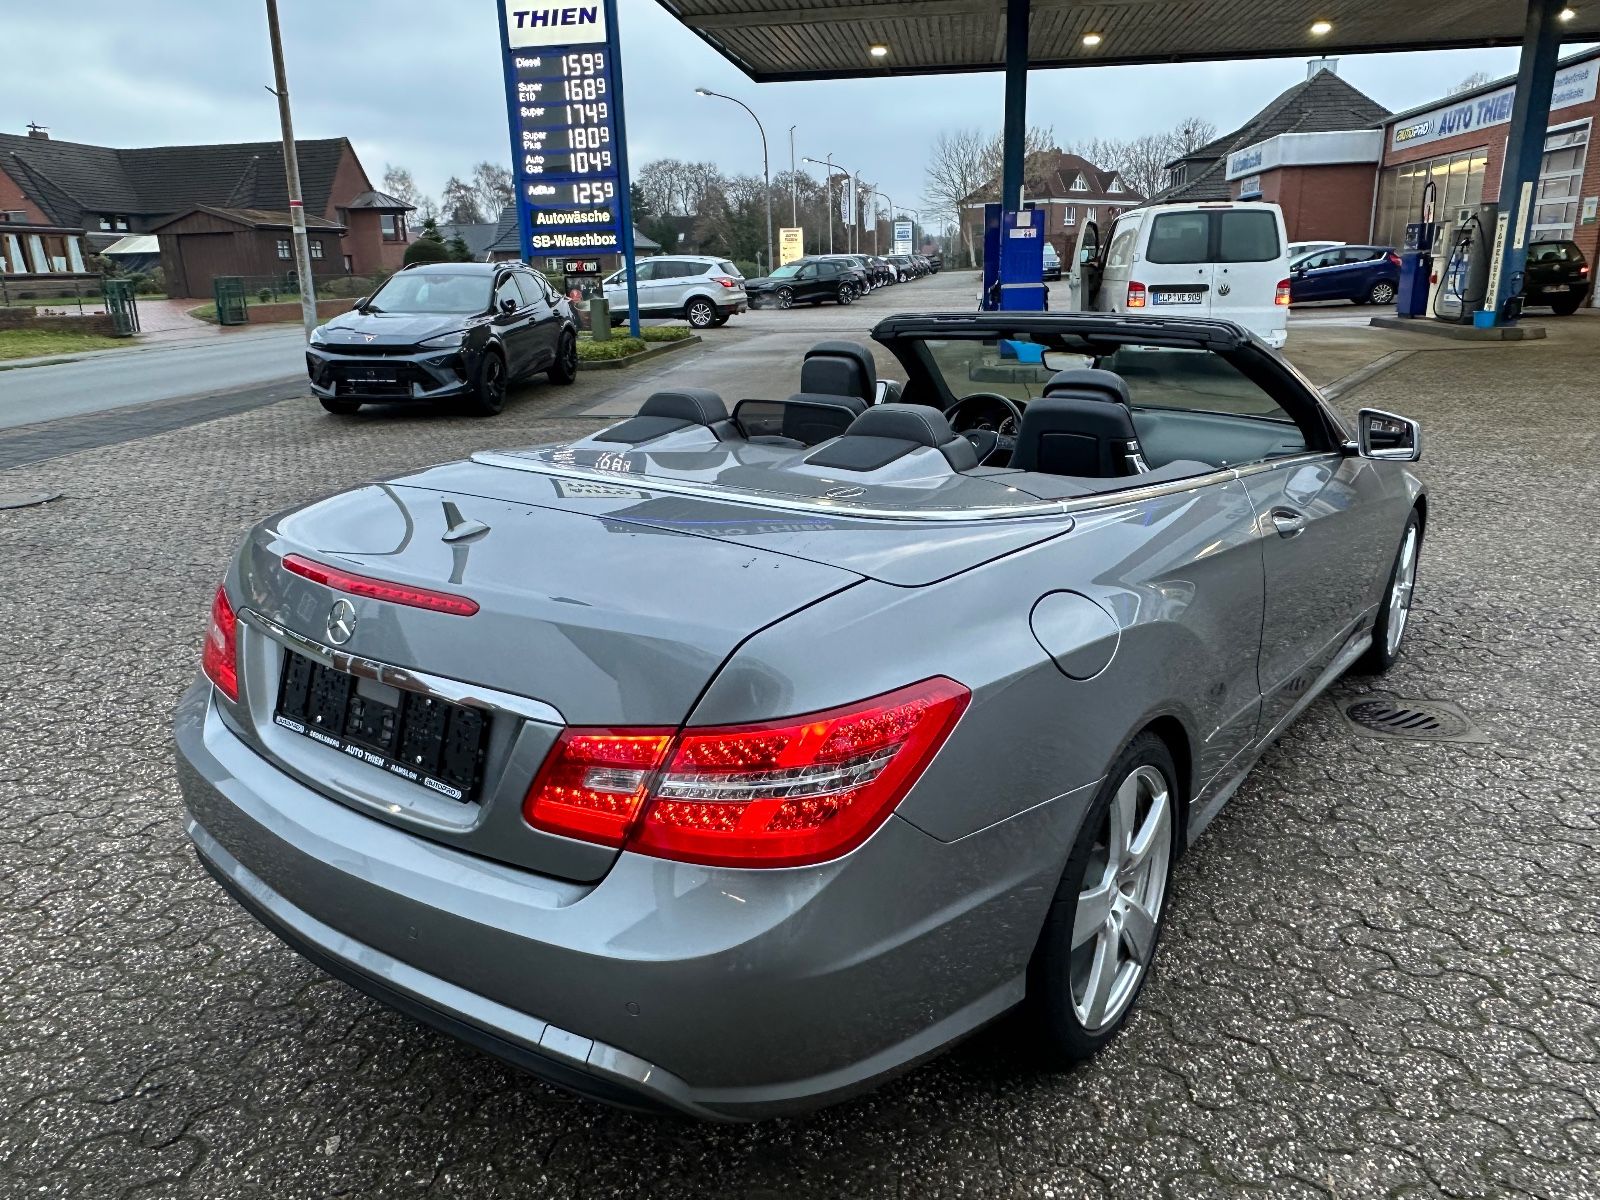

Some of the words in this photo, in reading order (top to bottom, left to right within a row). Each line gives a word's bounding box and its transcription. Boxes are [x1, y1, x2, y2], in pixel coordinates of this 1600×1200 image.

[513, 6, 597, 28] THIEN
[515, 57, 541, 68] Diesel
[518, 83, 542, 93] Super
[519, 92, 536, 102] E10
[520, 107, 545, 117] Super
[1439, 104, 1473, 136] AUTO
[522, 131, 547, 141] Super
[523, 141, 542, 150] Plus
[525, 155, 545, 164] Auto
[526, 165, 544, 174] Gas
[536, 210, 611, 225] Autowäsche
[532, 233, 617, 248] SB-Waschbox
[1159, 293, 1172, 301] CLP
[1177, 293, 1186, 301] VE
[345, 745, 364, 757] AUTO
[364, 751, 385, 767] THIEN
